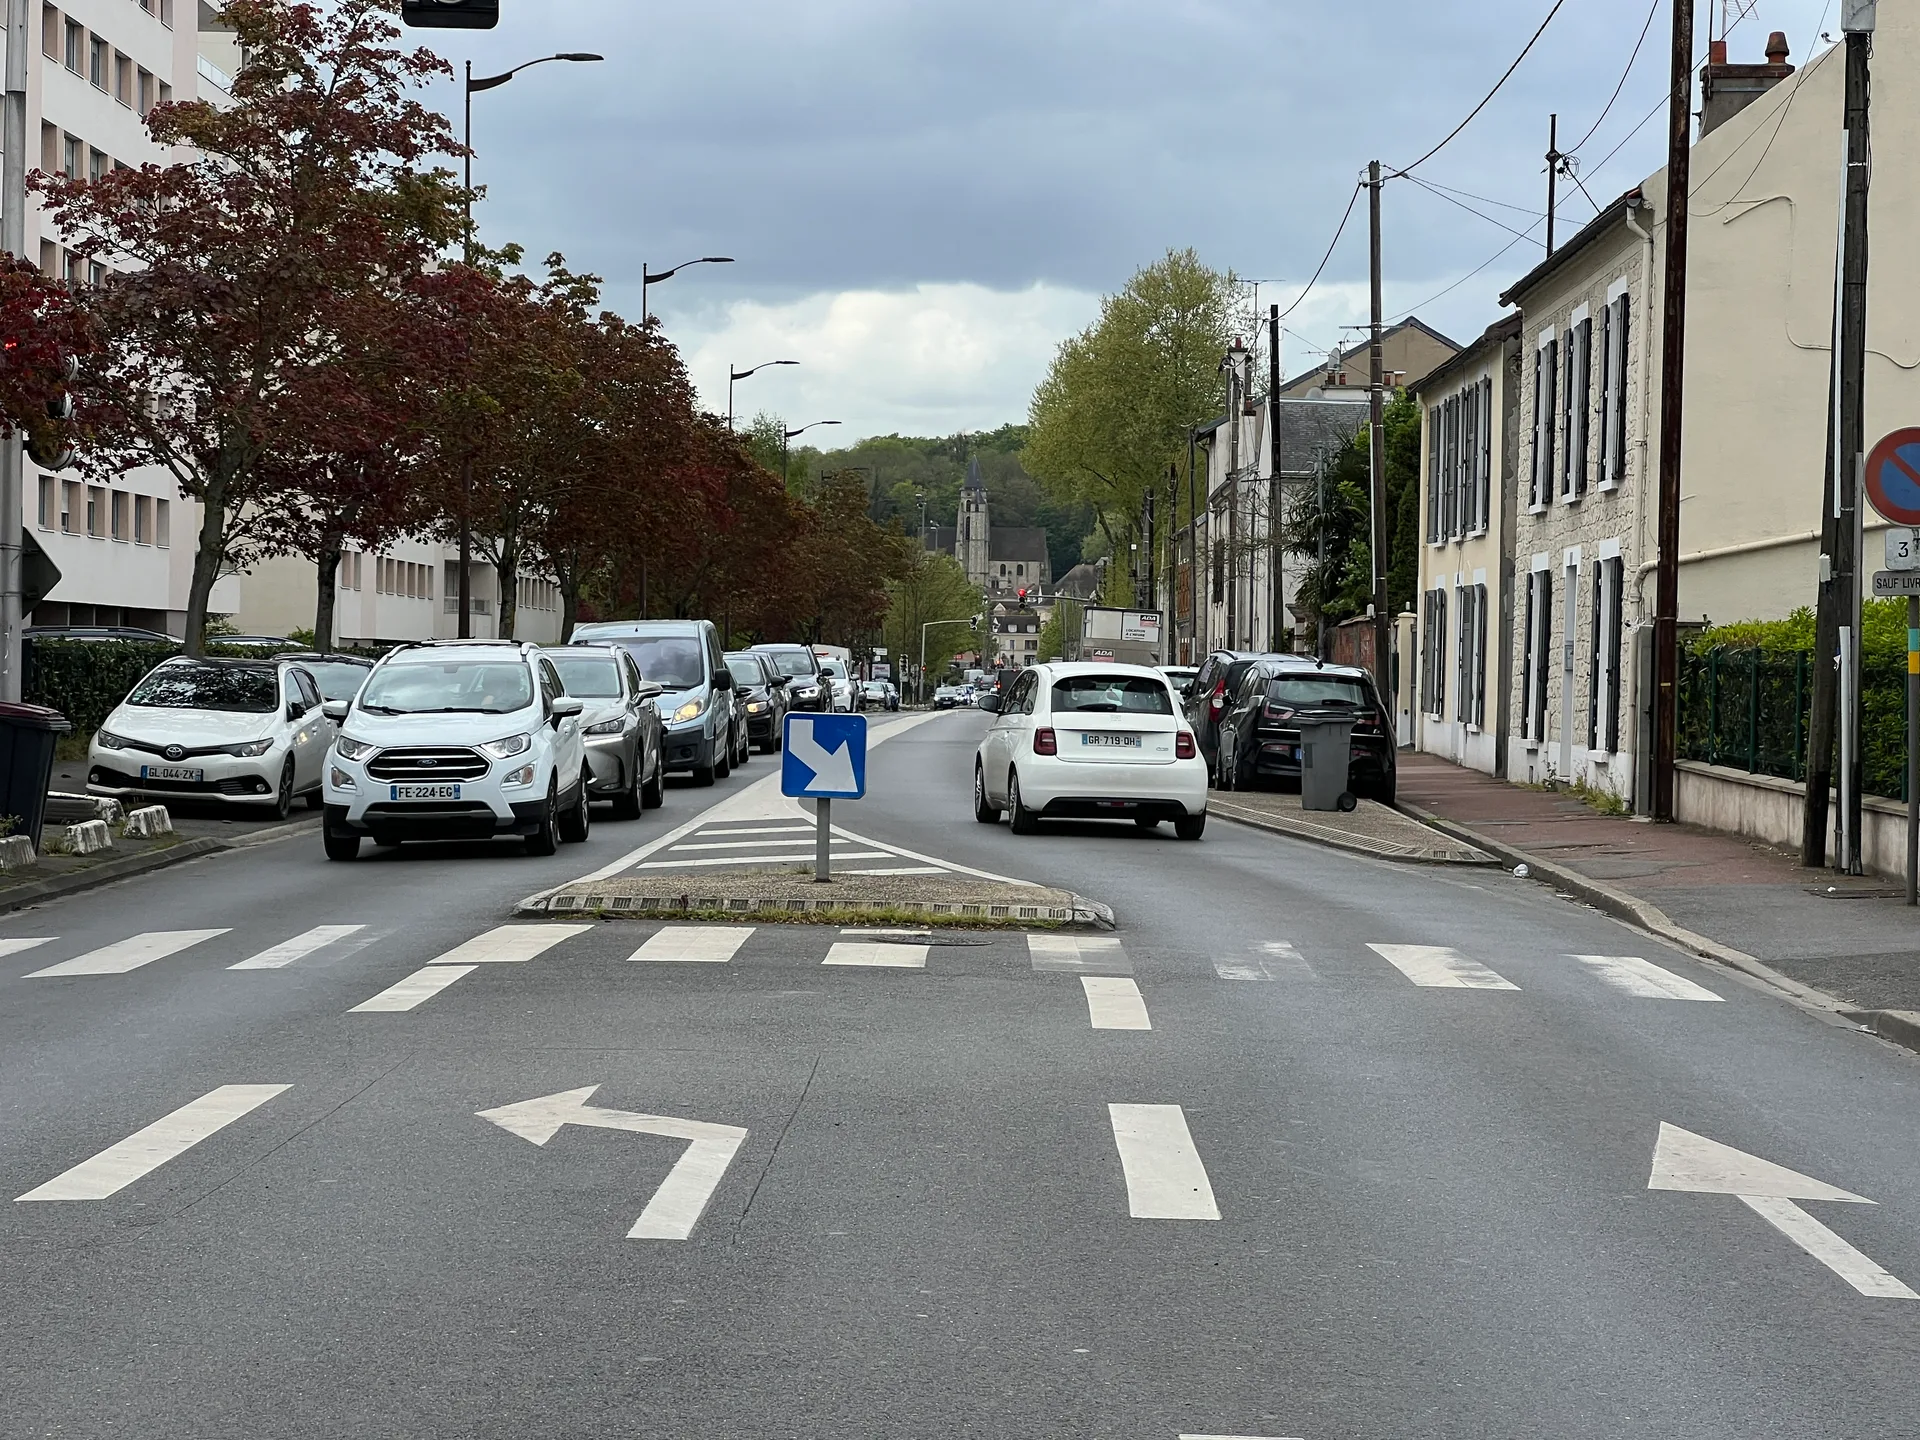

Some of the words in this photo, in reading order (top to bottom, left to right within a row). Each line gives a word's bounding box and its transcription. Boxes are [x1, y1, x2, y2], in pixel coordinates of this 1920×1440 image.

[1876, 577, 1899, 589] SAUF
[1088, 735, 1136, 746] GR-719-QH
[148, 767, 194, 780] GL-044-ZX
[398, 786, 453, 798] FE-224-EG
